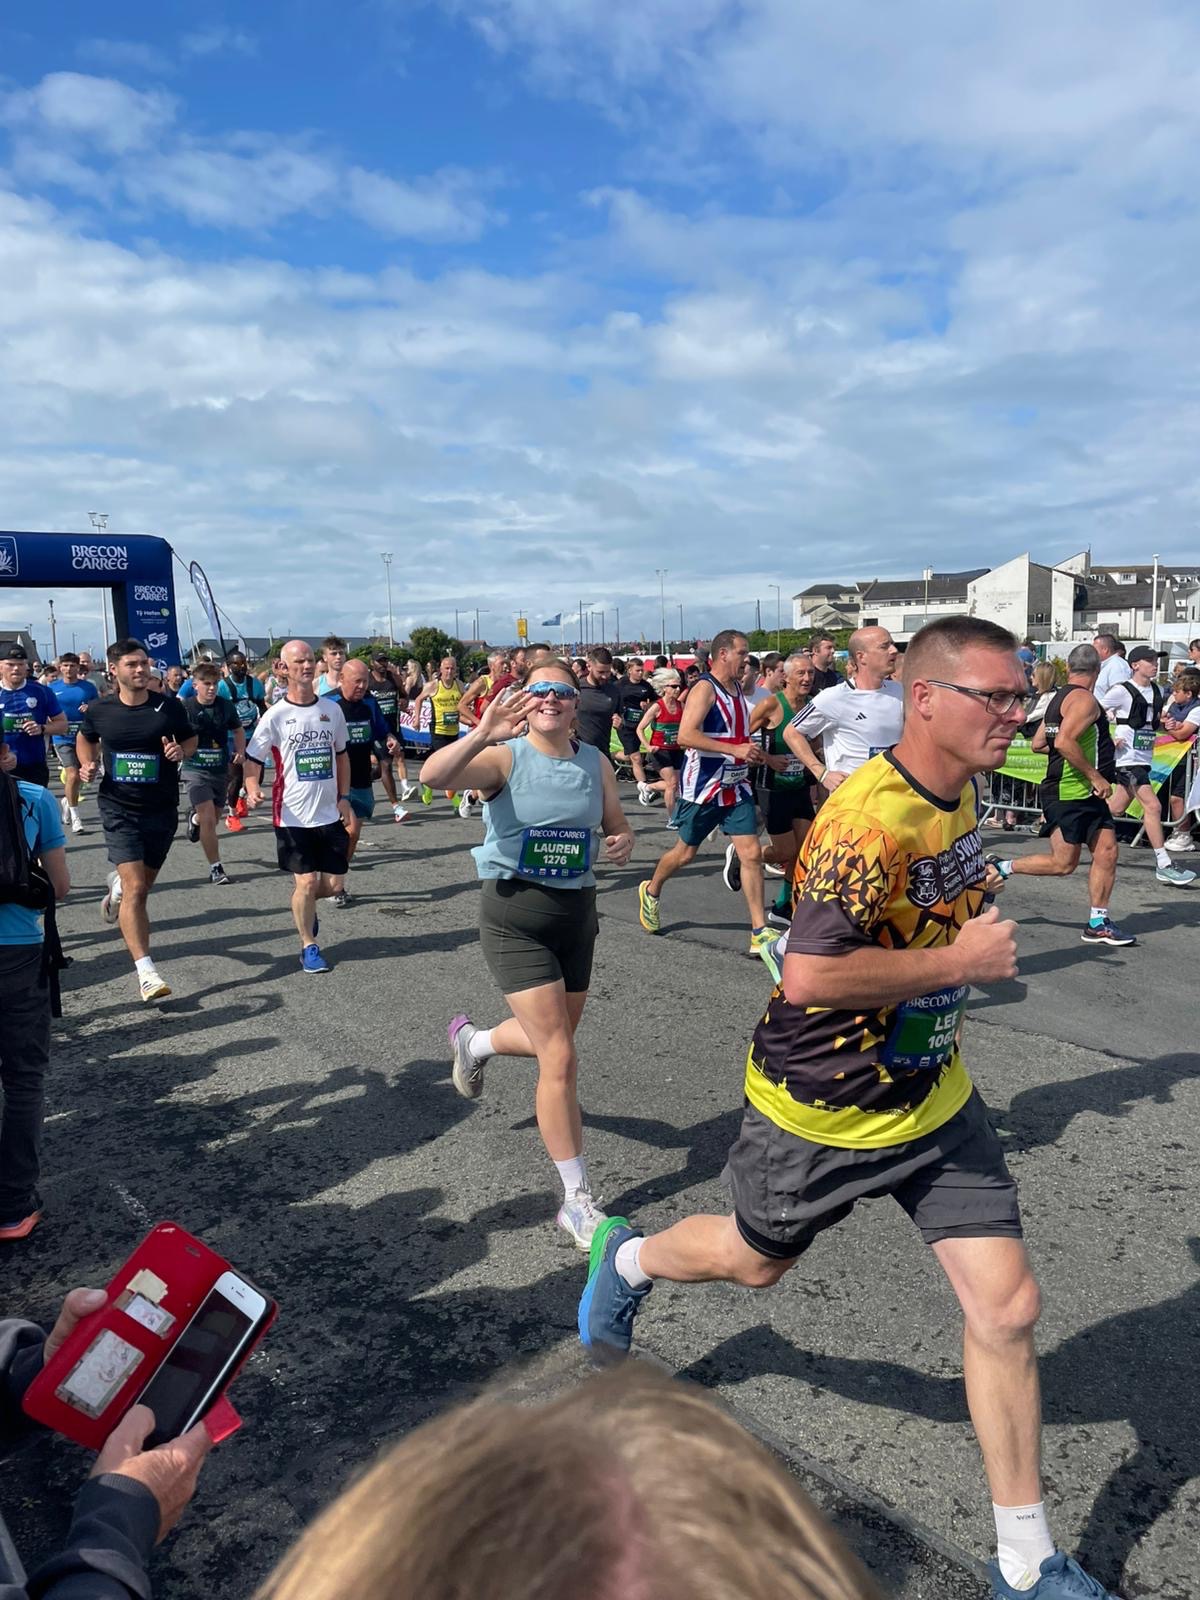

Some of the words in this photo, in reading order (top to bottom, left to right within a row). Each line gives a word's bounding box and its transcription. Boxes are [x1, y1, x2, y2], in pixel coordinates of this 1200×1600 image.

[71, 545, 128, 558] BRECON
[72, 557, 129, 570] CARREG
[134, 585, 168, 594] BRECON
[134, 593, 168, 601] CARREG
[288, 730, 333, 745] SOSPAN
[127, 761, 146, 769] TOM
[299, 756, 331, 764] ANTHONY
[529, 829, 558, 838] BRECON
[558, 830, 586, 839] CARREG
[533, 842, 580, 855] LAUREN
[542, 855, 568, 865] 1276
[906, 993, 951, 1008] BRECON
